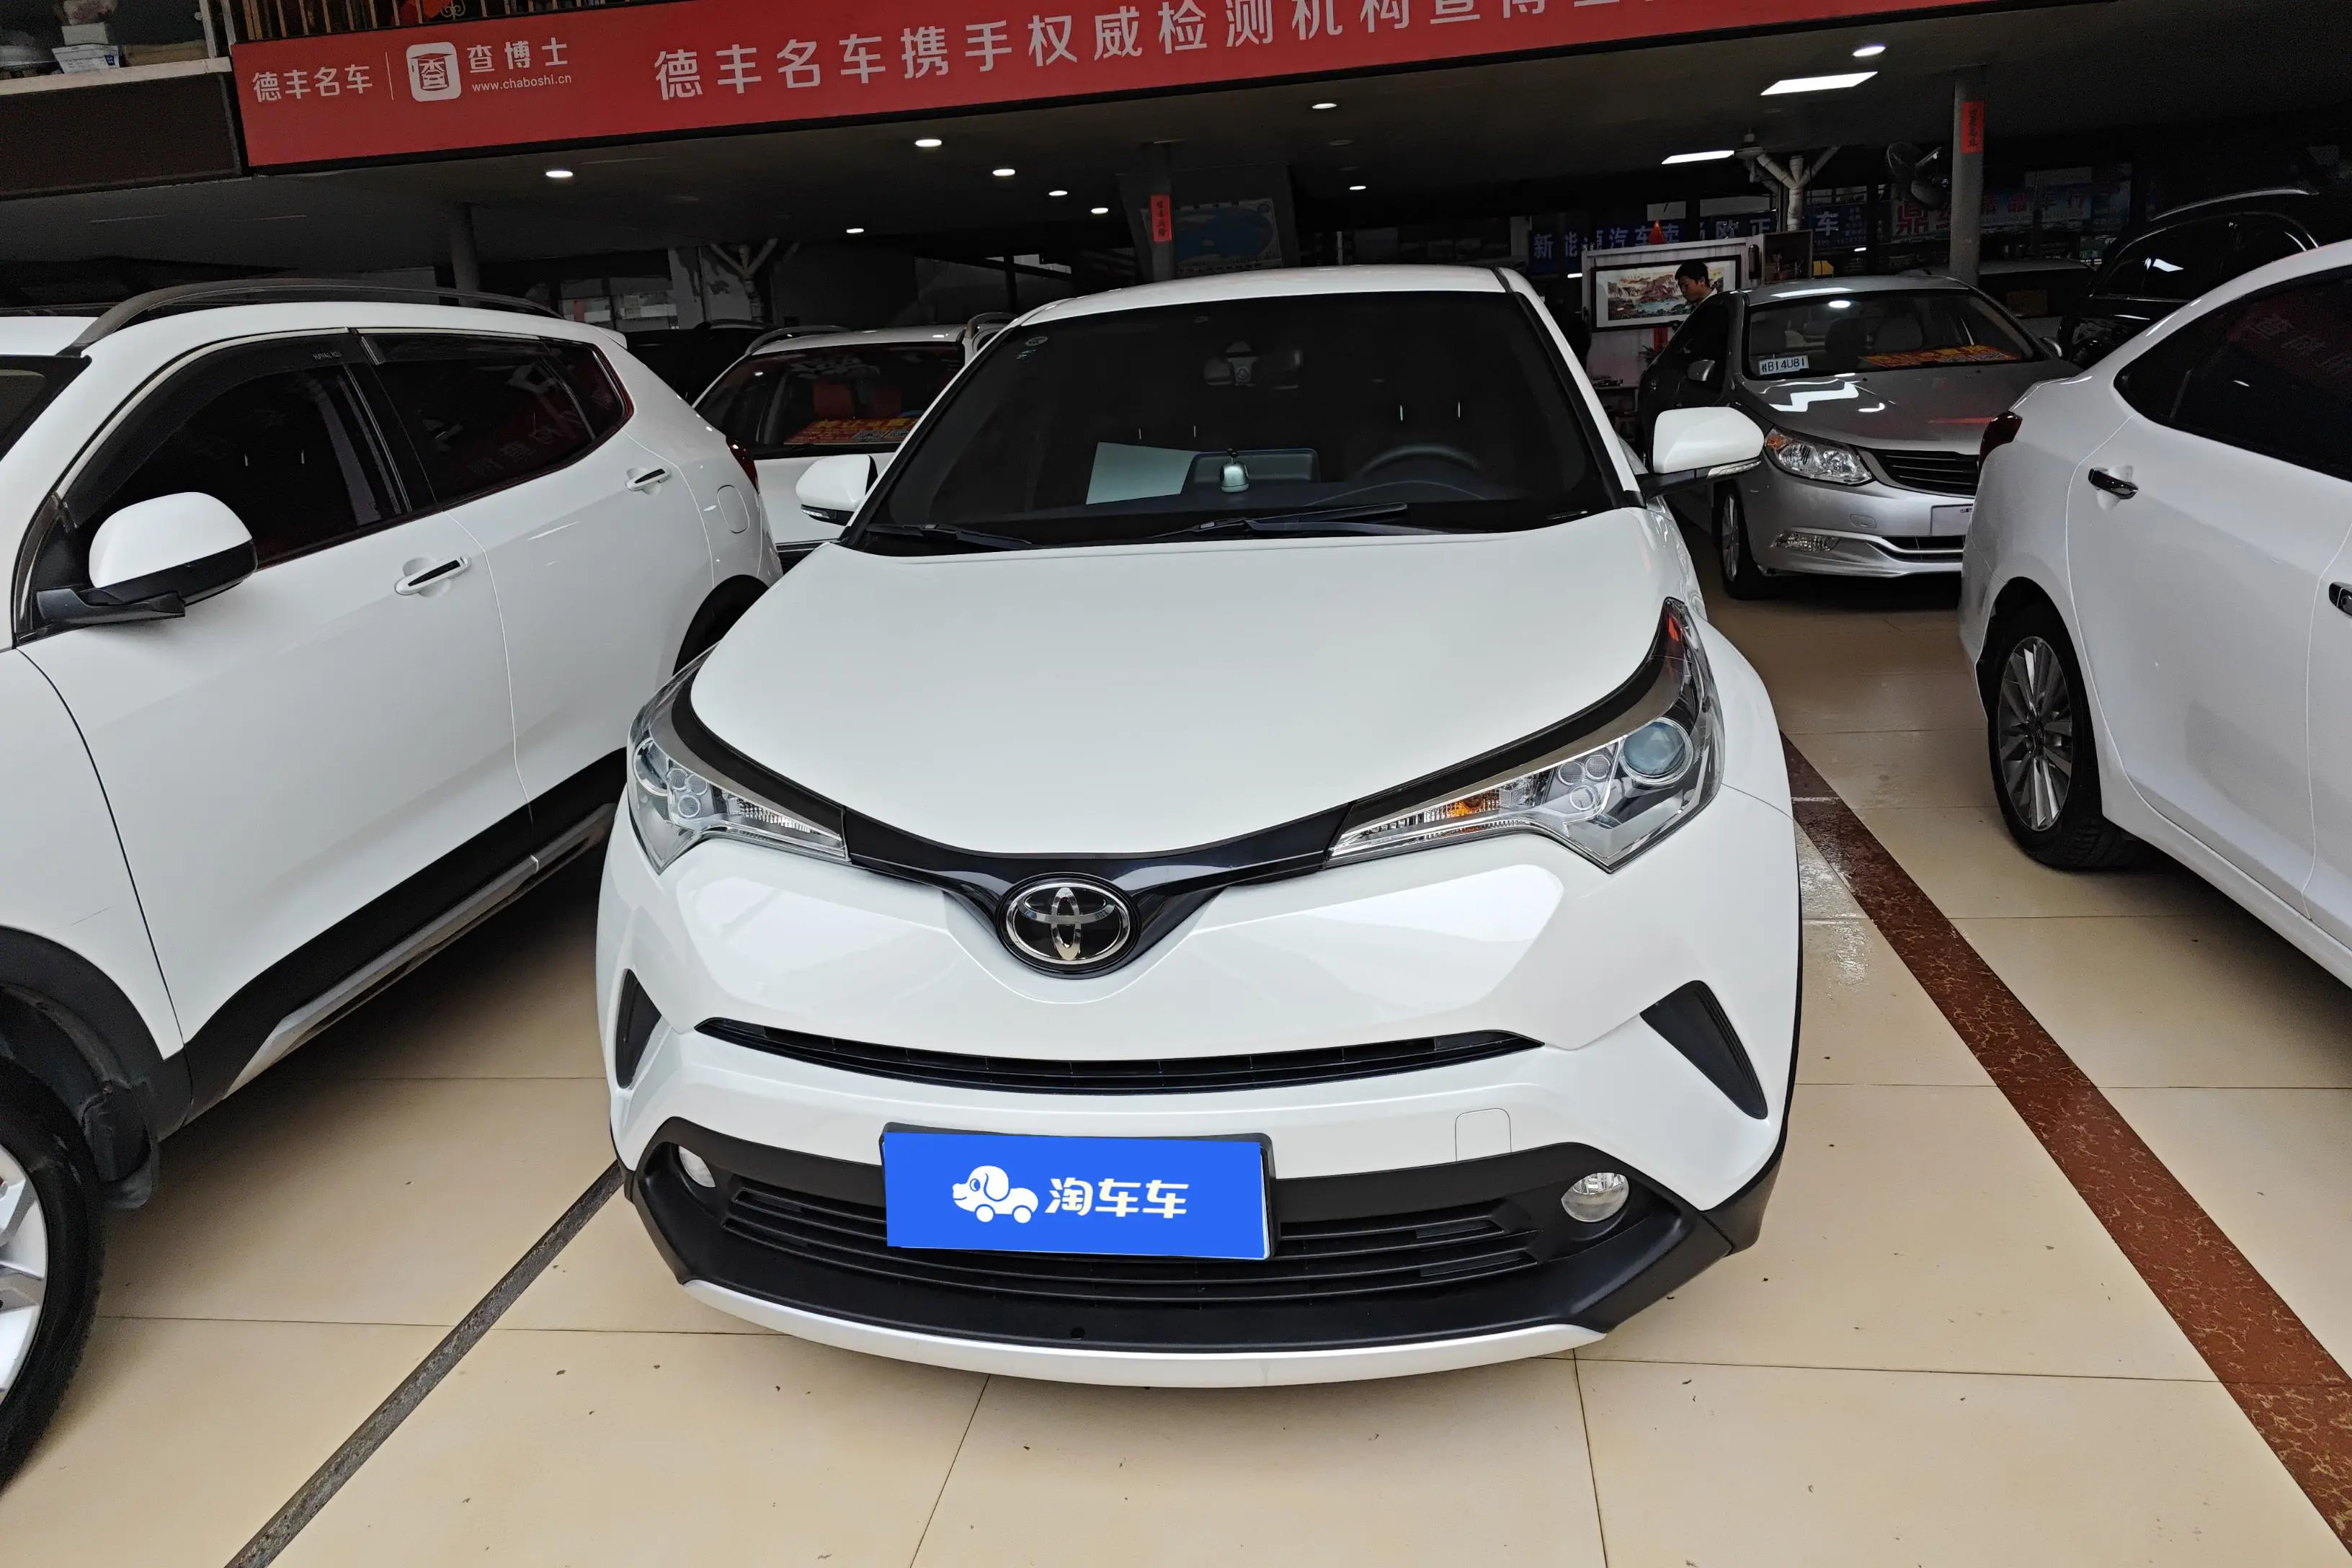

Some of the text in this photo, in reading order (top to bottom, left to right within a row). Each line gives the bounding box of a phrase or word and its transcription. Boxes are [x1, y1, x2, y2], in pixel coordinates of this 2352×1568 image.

[467, 37, 568, 73] 查博士
[654, 0, 1620, 101] 德丰名车携手权威检测机构
[252, 64, 373, 103] 德丰名车
[471, 74, 572, 92] www.chaboshi.cn
